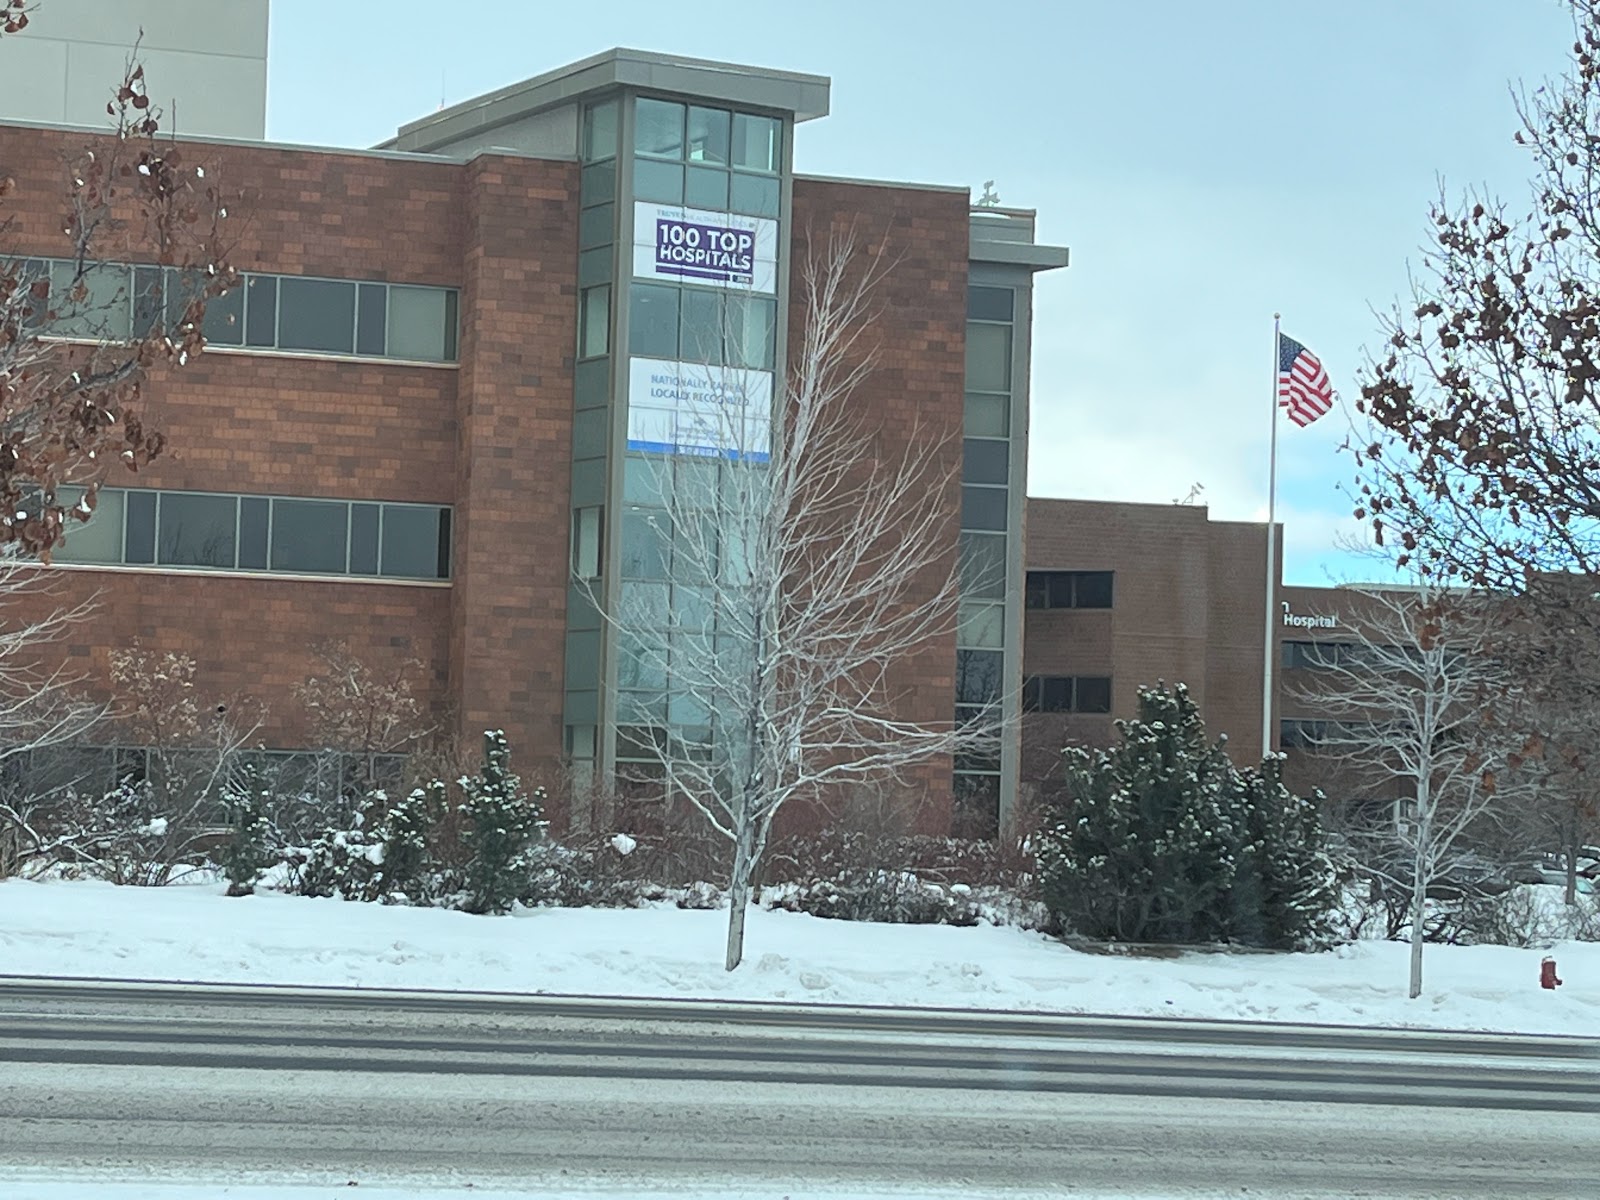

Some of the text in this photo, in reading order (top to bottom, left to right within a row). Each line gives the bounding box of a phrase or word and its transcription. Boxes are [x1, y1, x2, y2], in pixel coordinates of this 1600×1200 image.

[660, 224, 752, 253] 100 TOP
[660, 244, 751, 271] HOSPITALS
[650, 375, 708, 389] NATIONALLY
[650, 387, 690, 401] LOCALLY
[1283, 613, 1337, 630] Hospital
